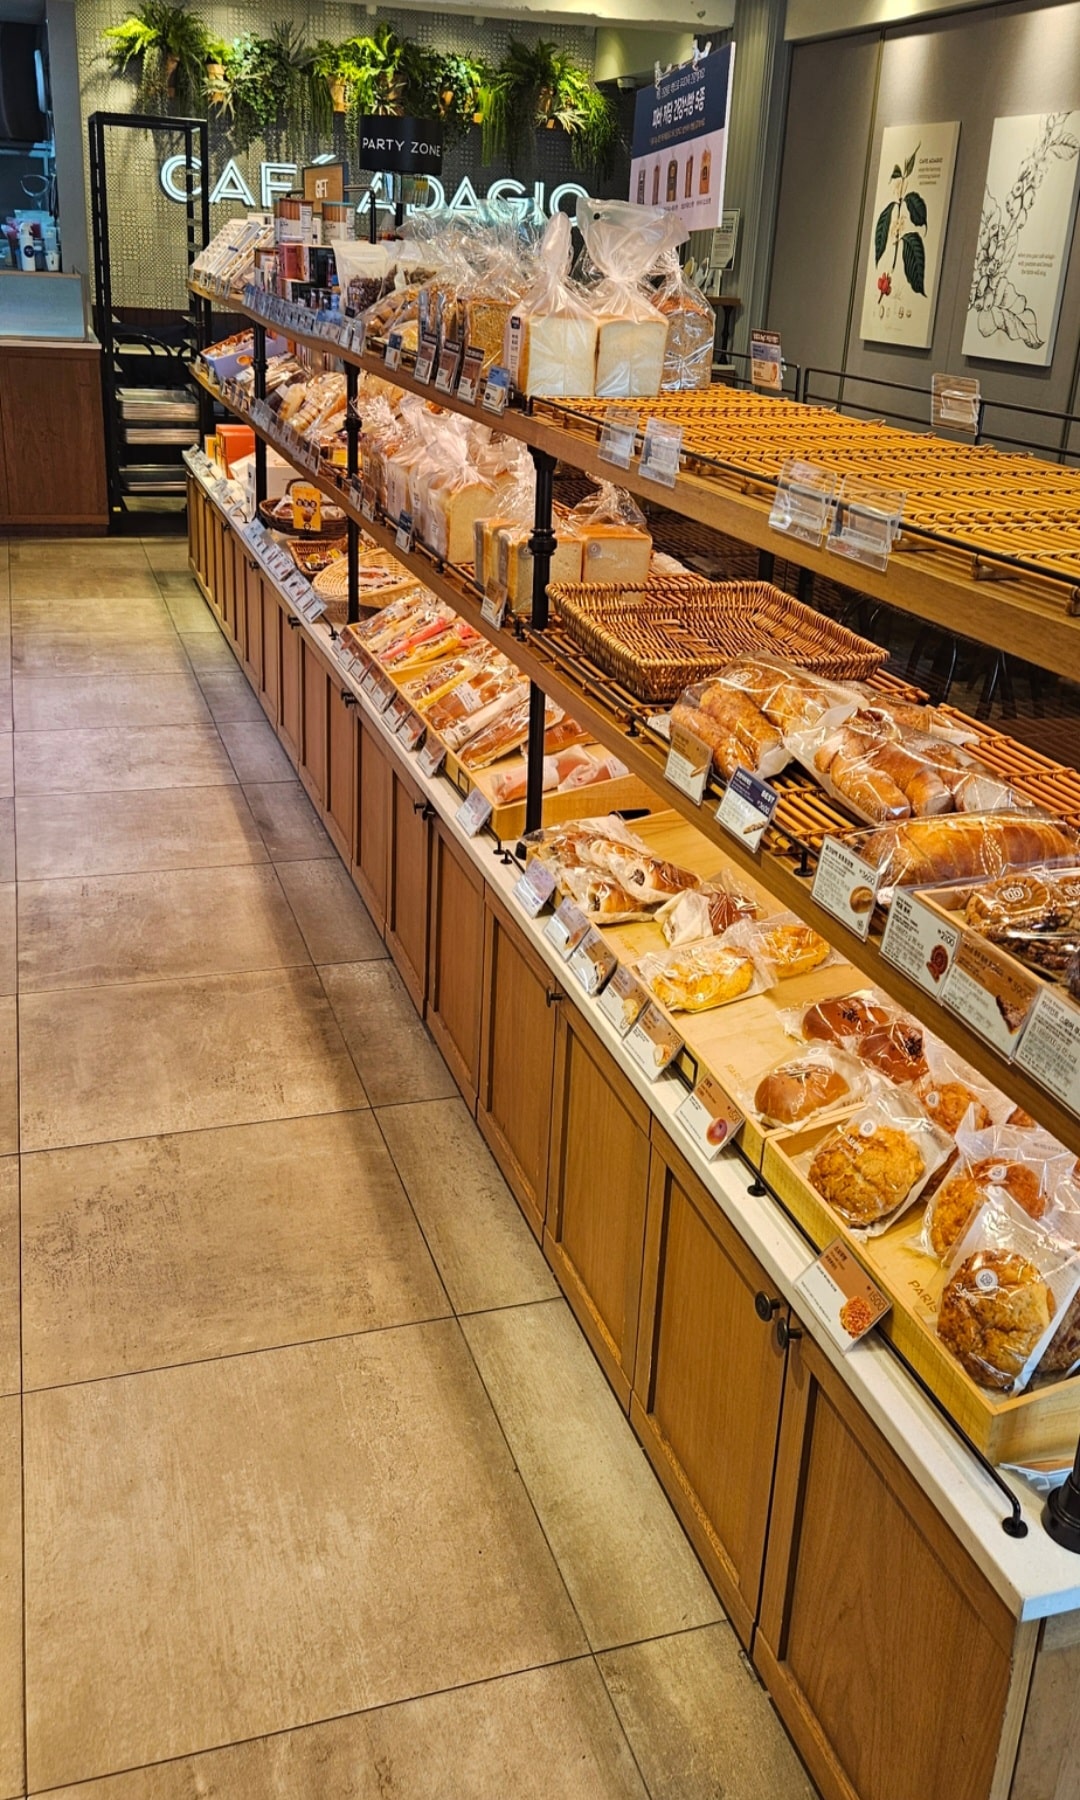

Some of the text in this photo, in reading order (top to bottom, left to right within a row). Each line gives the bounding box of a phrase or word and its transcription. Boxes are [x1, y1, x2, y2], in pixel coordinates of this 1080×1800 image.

[363, 137, 441, 157] PARTY ZONE
[160, 154, 590, 228] CAF ADAGIO
[761, 790, 775, 804] BEST
